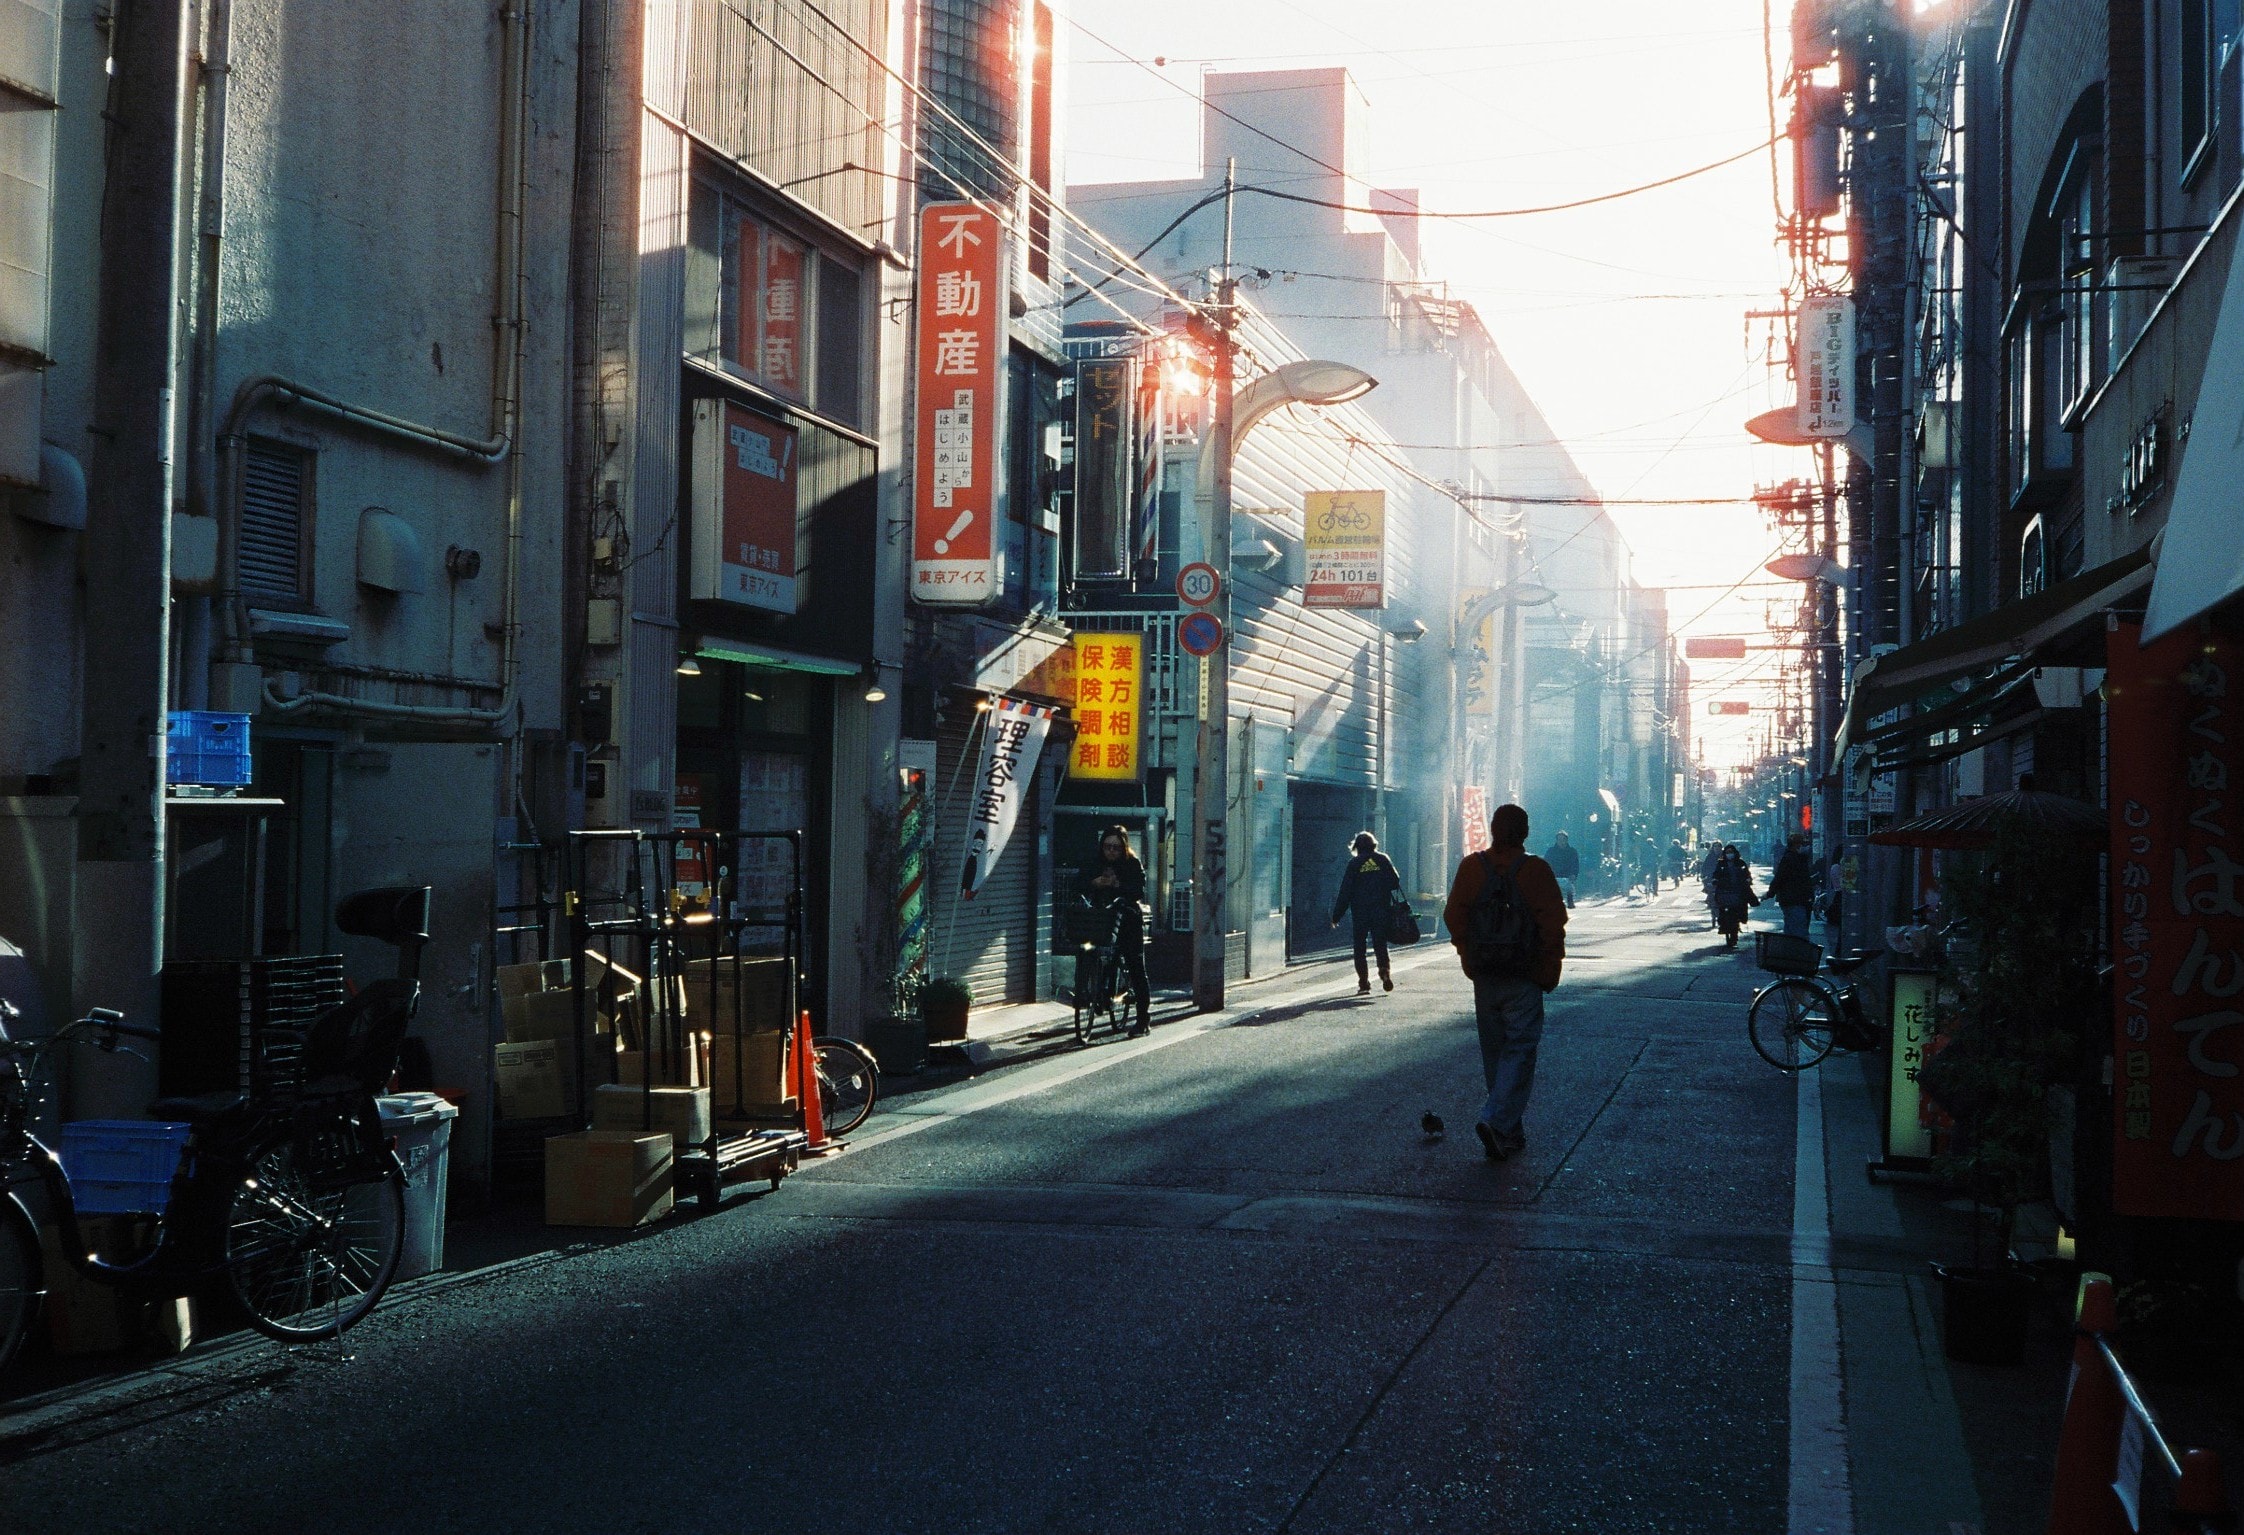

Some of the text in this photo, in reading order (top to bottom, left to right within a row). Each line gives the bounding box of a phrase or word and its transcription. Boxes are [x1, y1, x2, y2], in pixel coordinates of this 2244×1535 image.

[934, 213, 982, 376] 不動産
[938, 414, 950, 503] はじめよう
[954, 393, 970, 486] 武蔵小山から
[918, 570, 986, 585] 東京アイズ
[1187, 574, 1212, 595] 30
[1310, 569, 1336, 581] 24h
[1078, 645, 1104, 769] 保険調剤
[1107, 645, 1134, 770] 漢方相談
[975, 718, 1031, 825] 理容室
